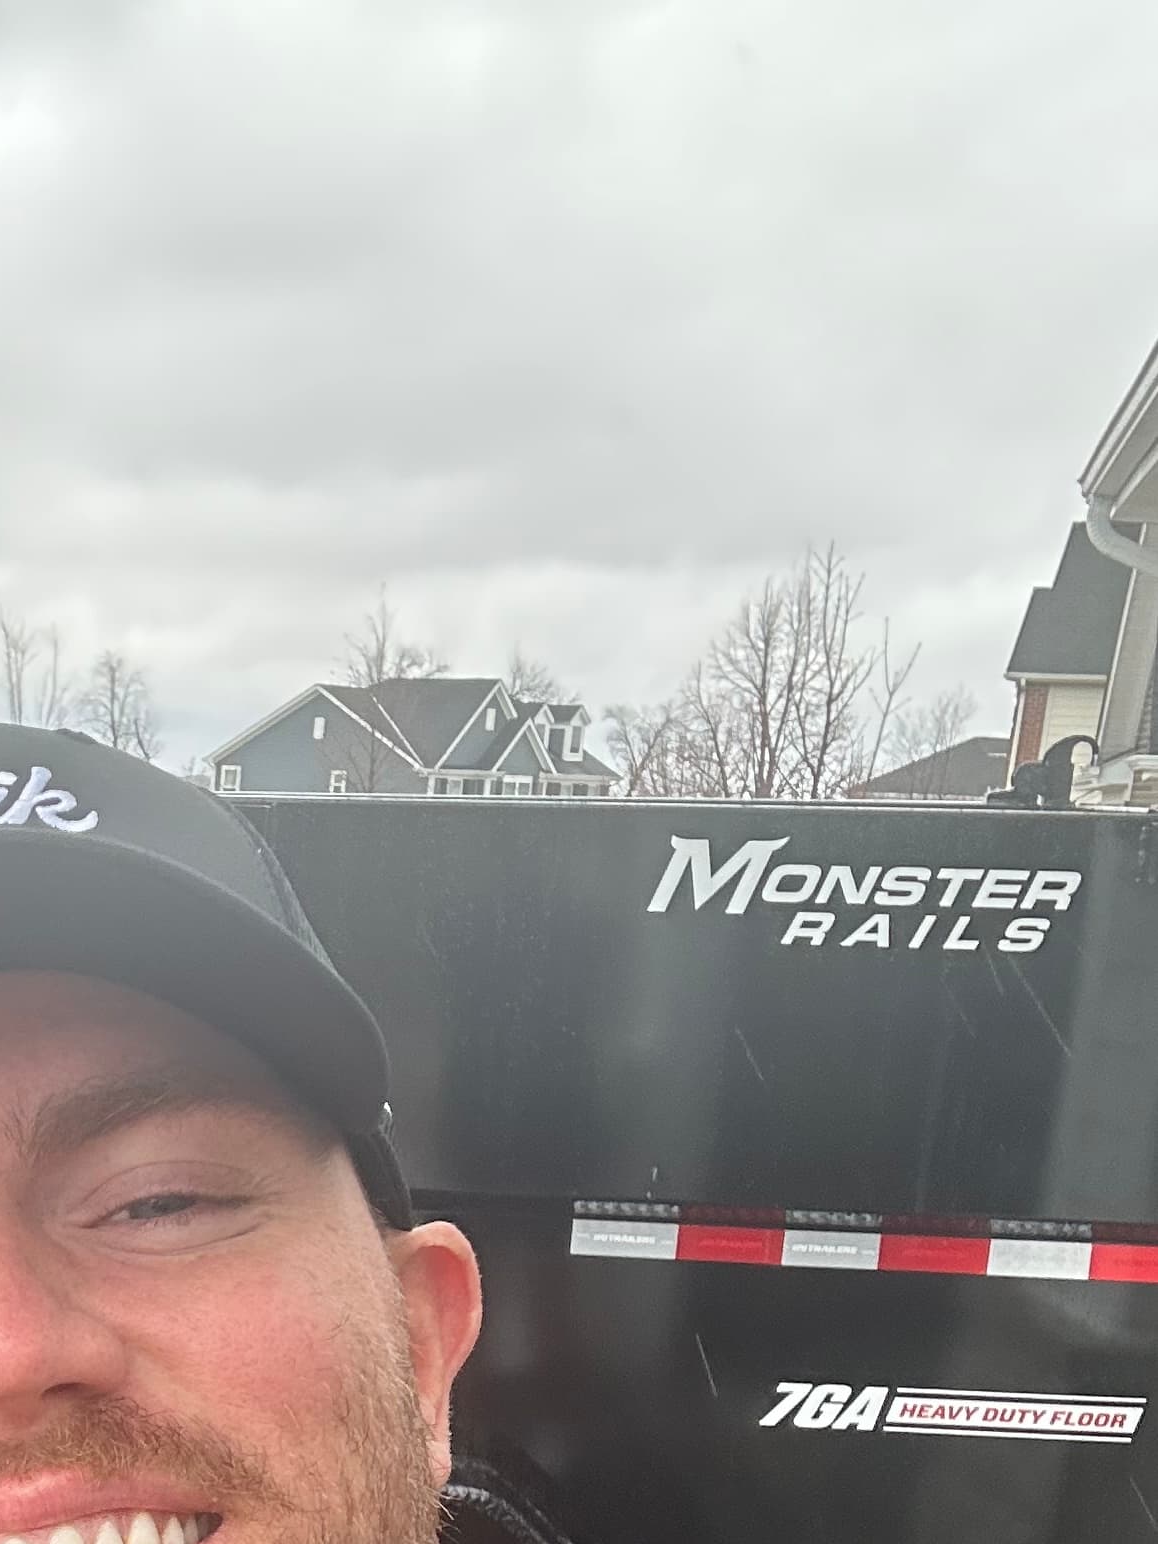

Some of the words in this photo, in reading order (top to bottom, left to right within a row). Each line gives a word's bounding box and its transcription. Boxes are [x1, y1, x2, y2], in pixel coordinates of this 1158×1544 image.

[646, 835, 1082, 914] MONSTER
[780, 912, 1051, 953] RAILS
[759, 1382, 888, 1431] 7GA
[899, 1403, 978, 1423] HEAVY
[983, 1407, 1045, 1425] DUTY
[1050, 1410, 1127, 1428] FLOOR
